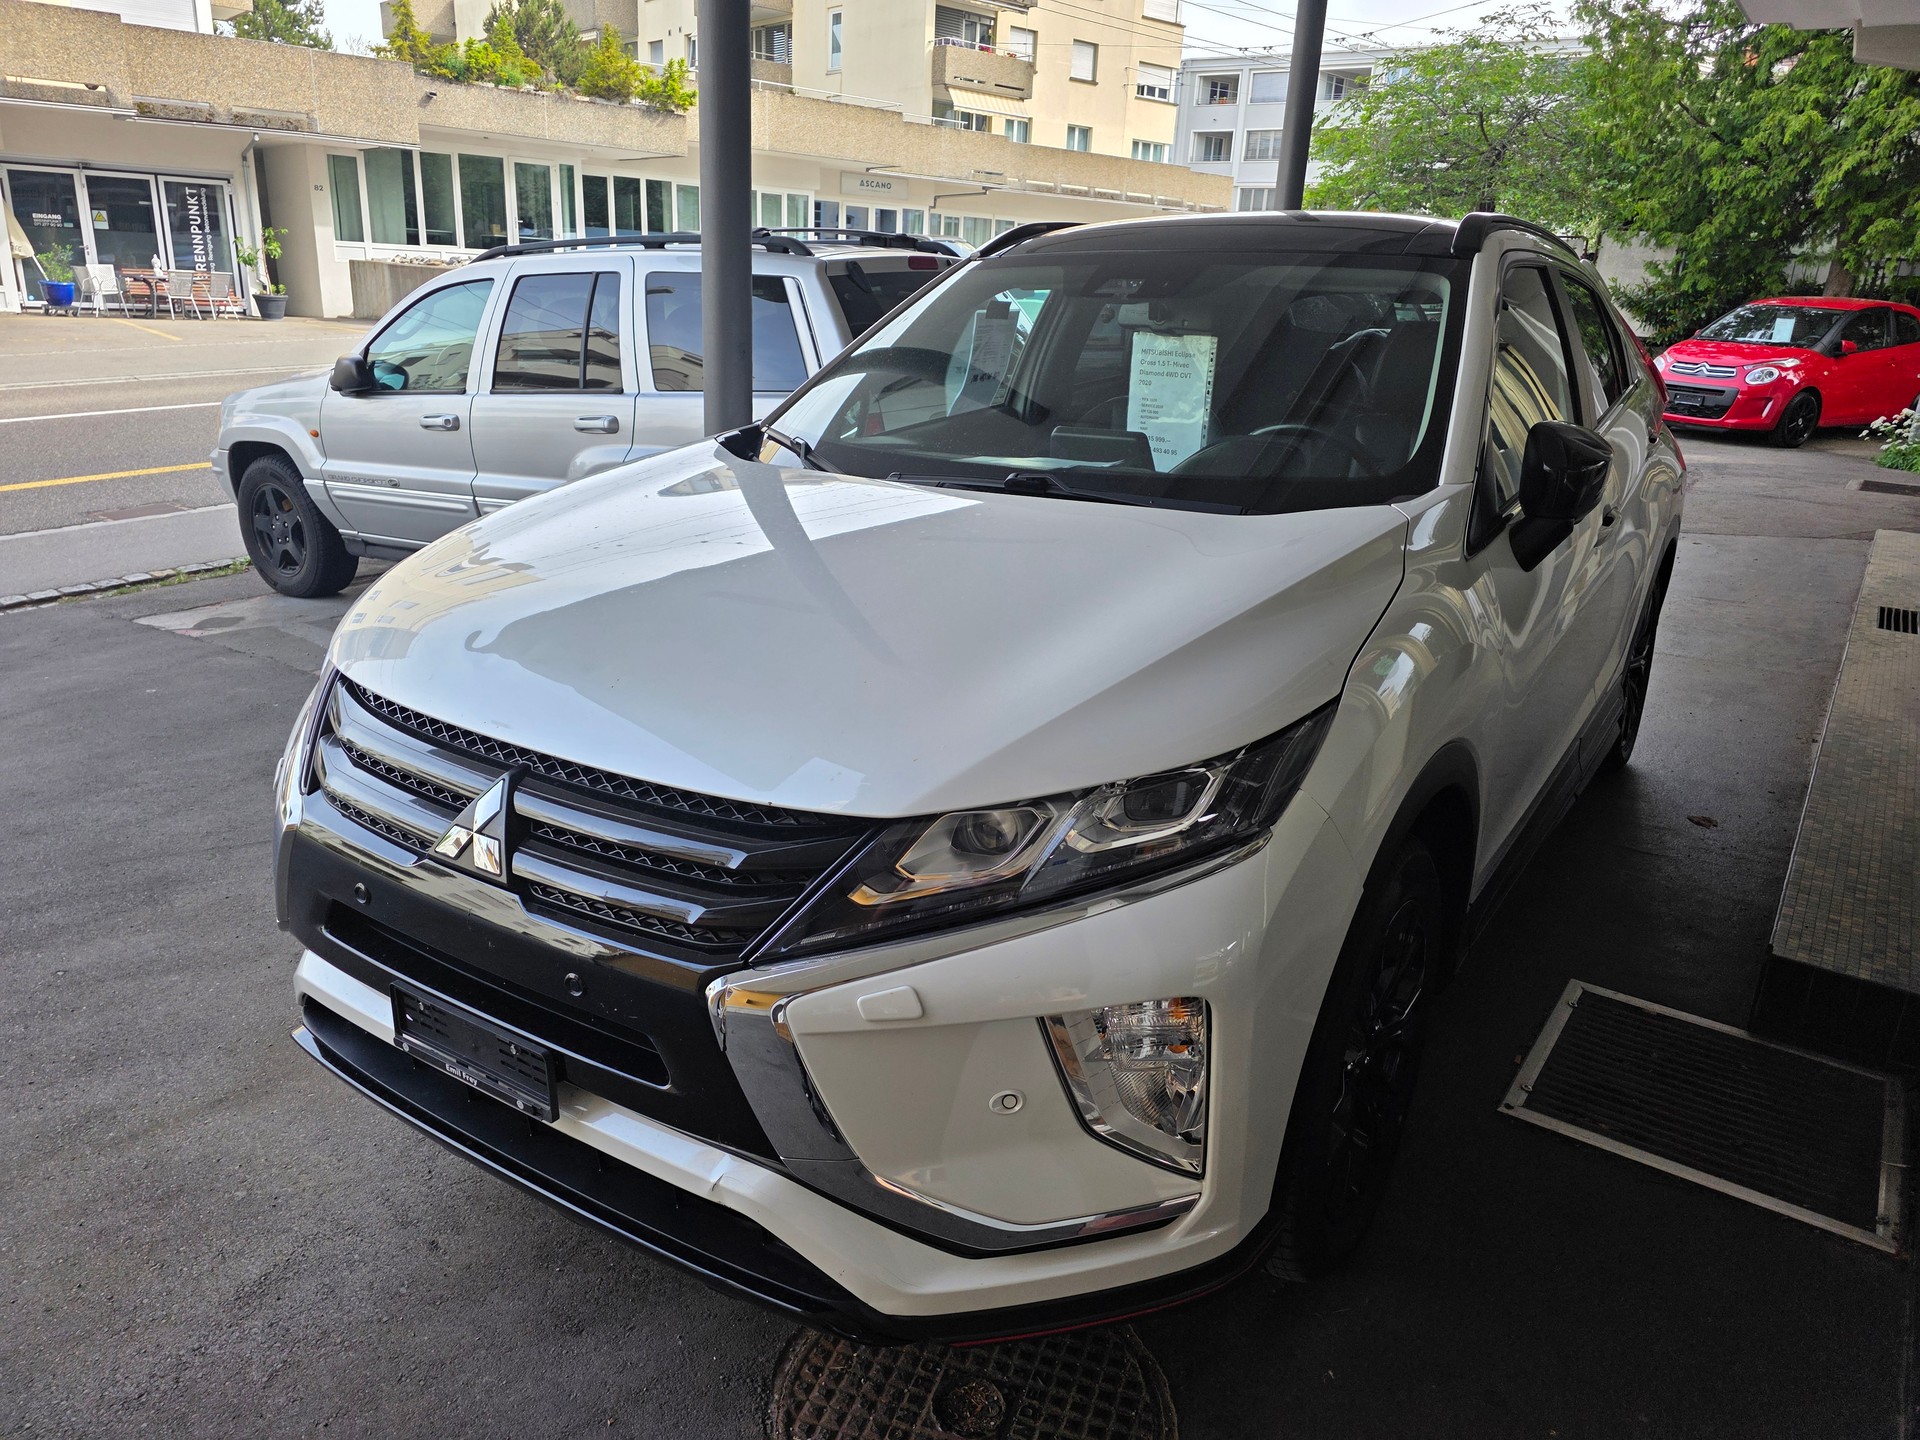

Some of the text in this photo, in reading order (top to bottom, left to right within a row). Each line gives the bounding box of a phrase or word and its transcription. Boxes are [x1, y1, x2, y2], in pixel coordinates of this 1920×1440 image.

[314, 184, 324, 192] 82
[859, 179, 891, 189] ASCANO
[32, 213, 62, 221] EINGANG
[1140, 358, 1156, 366] Cross
[1157, 359, 1166, 367] 1.5
[1172, 361, 1190, 369] Mivec
[1139, 368, 1165, 377] Diamond
[445, 1063, 477, 1086] Emil Frey
